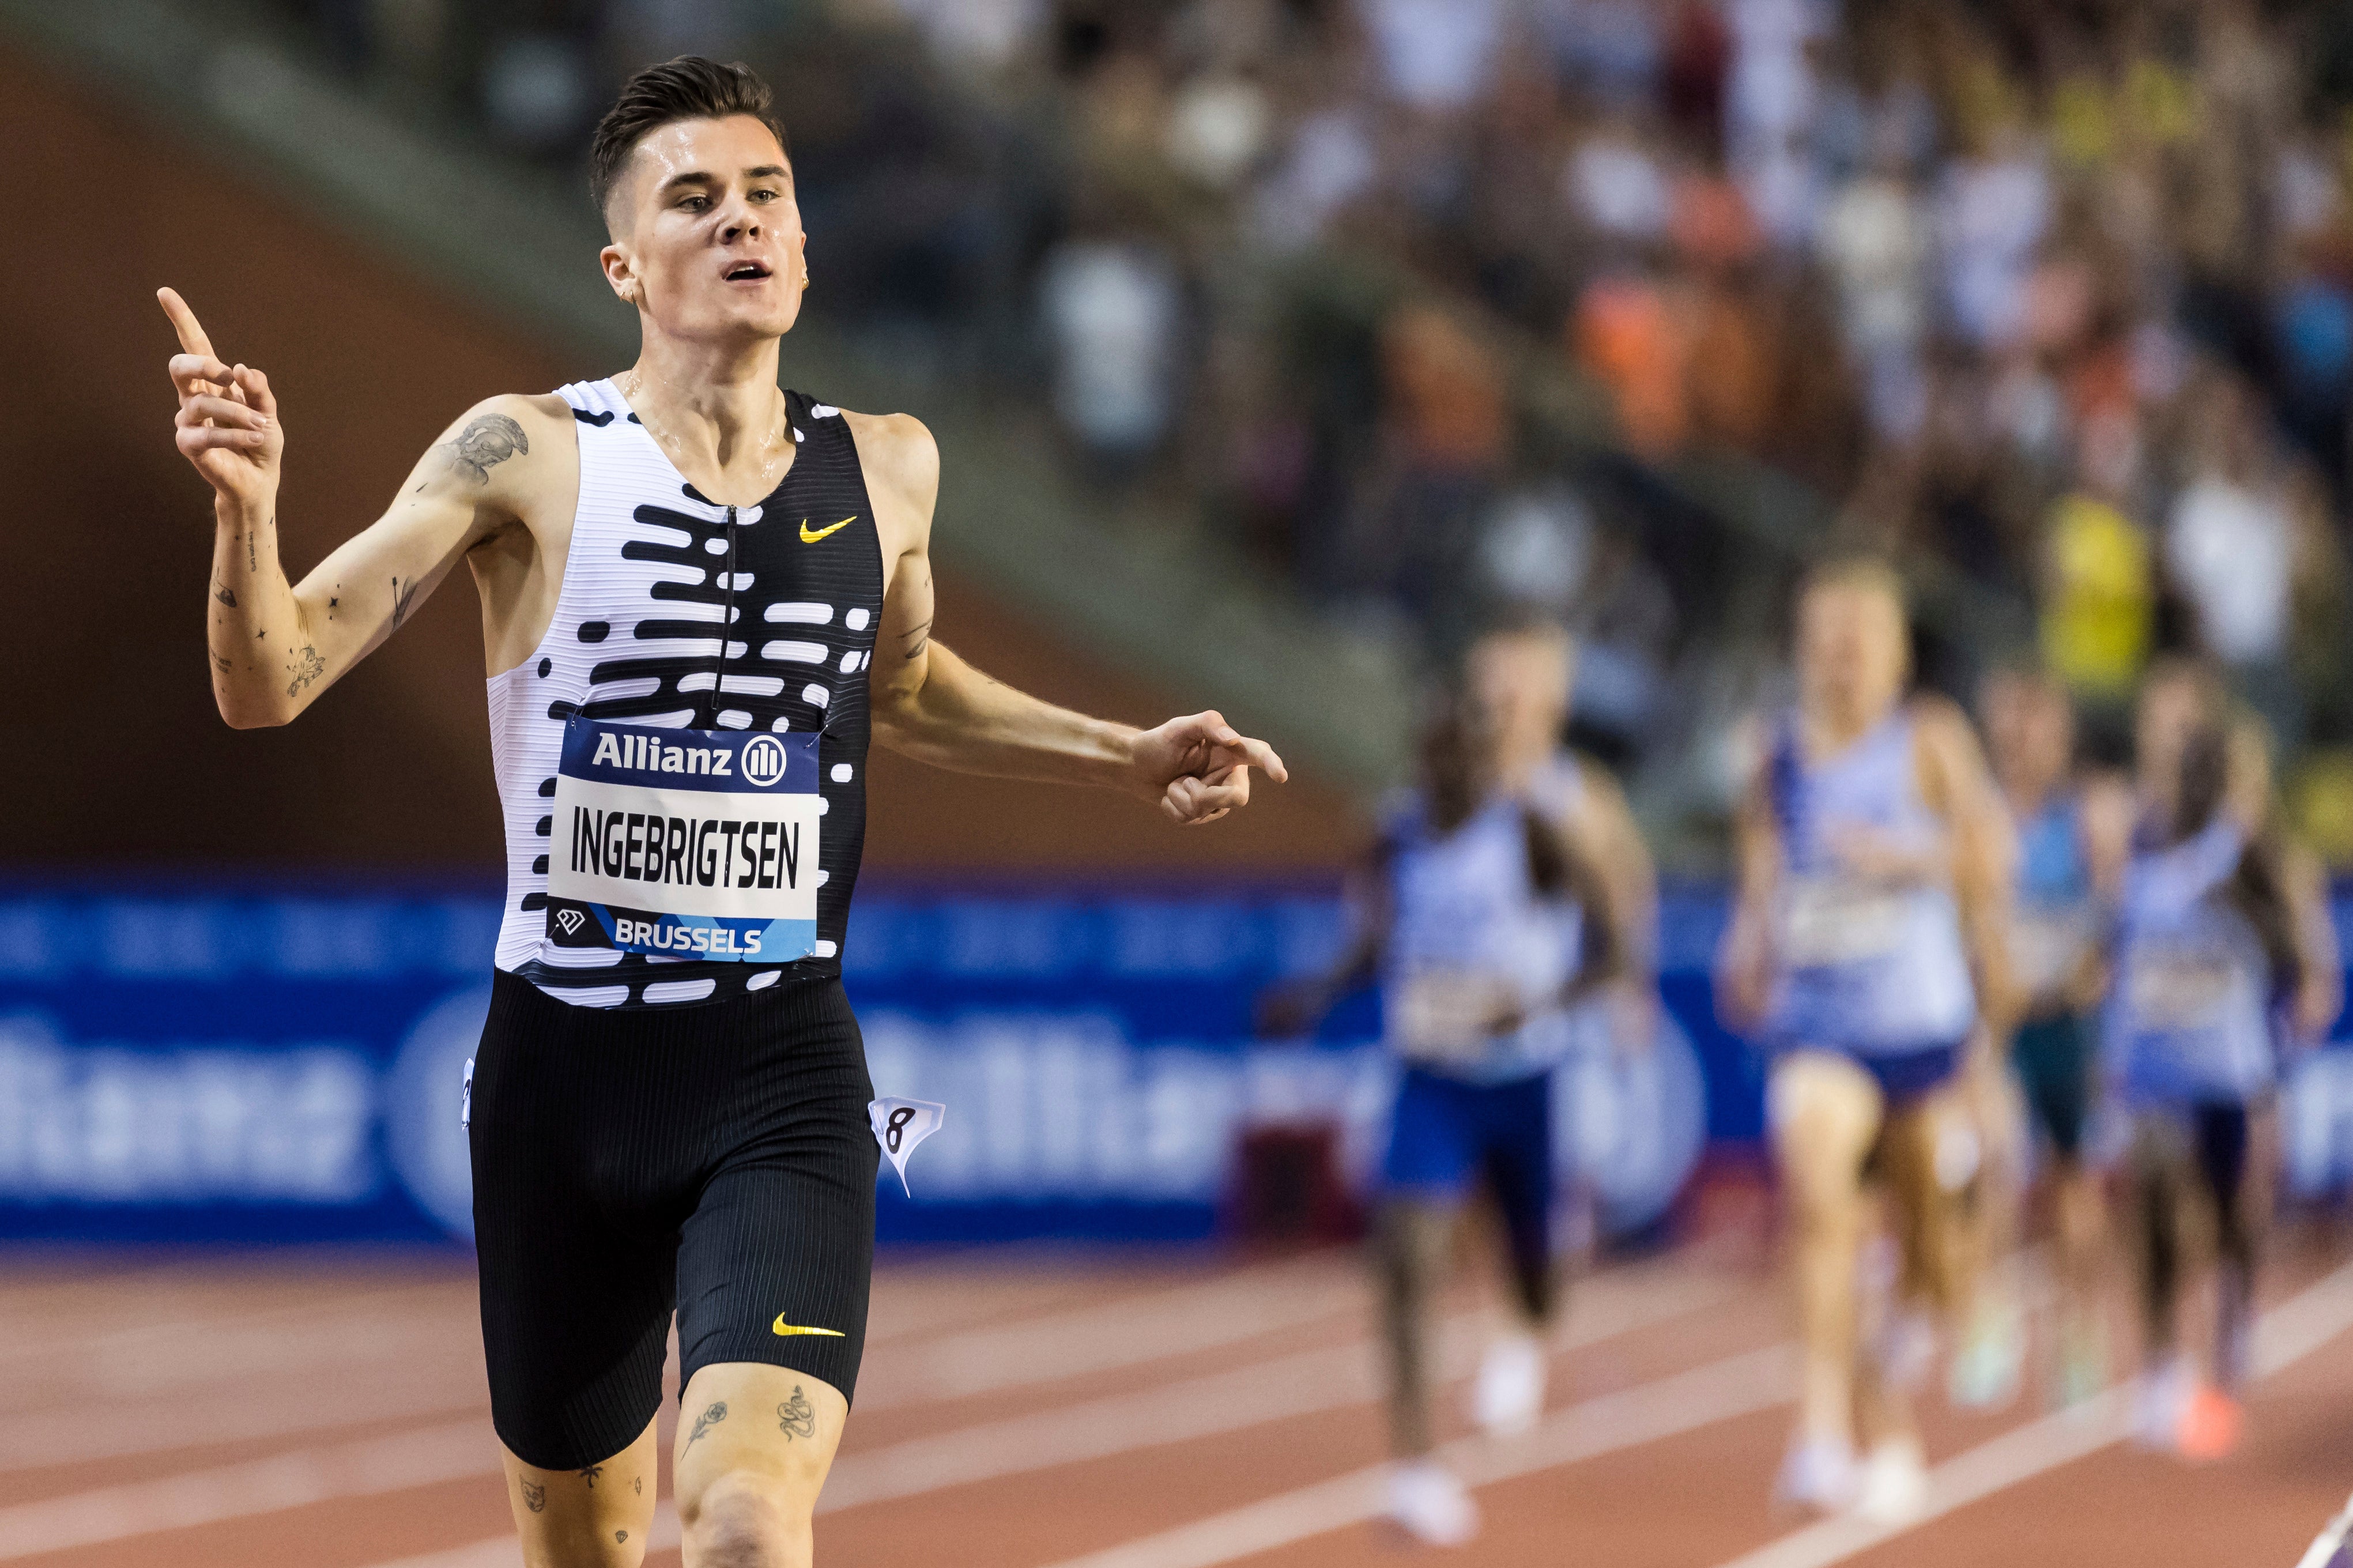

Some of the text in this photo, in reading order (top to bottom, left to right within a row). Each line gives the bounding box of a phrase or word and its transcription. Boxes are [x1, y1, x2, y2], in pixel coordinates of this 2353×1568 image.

[593, 732, 732, 775] Allianz
[572, 805, 799, 889] INGEBRIGTSEN
[615, 919, 761, 953] BRUSSELS
[886, 1107, 916, 1154] 8
